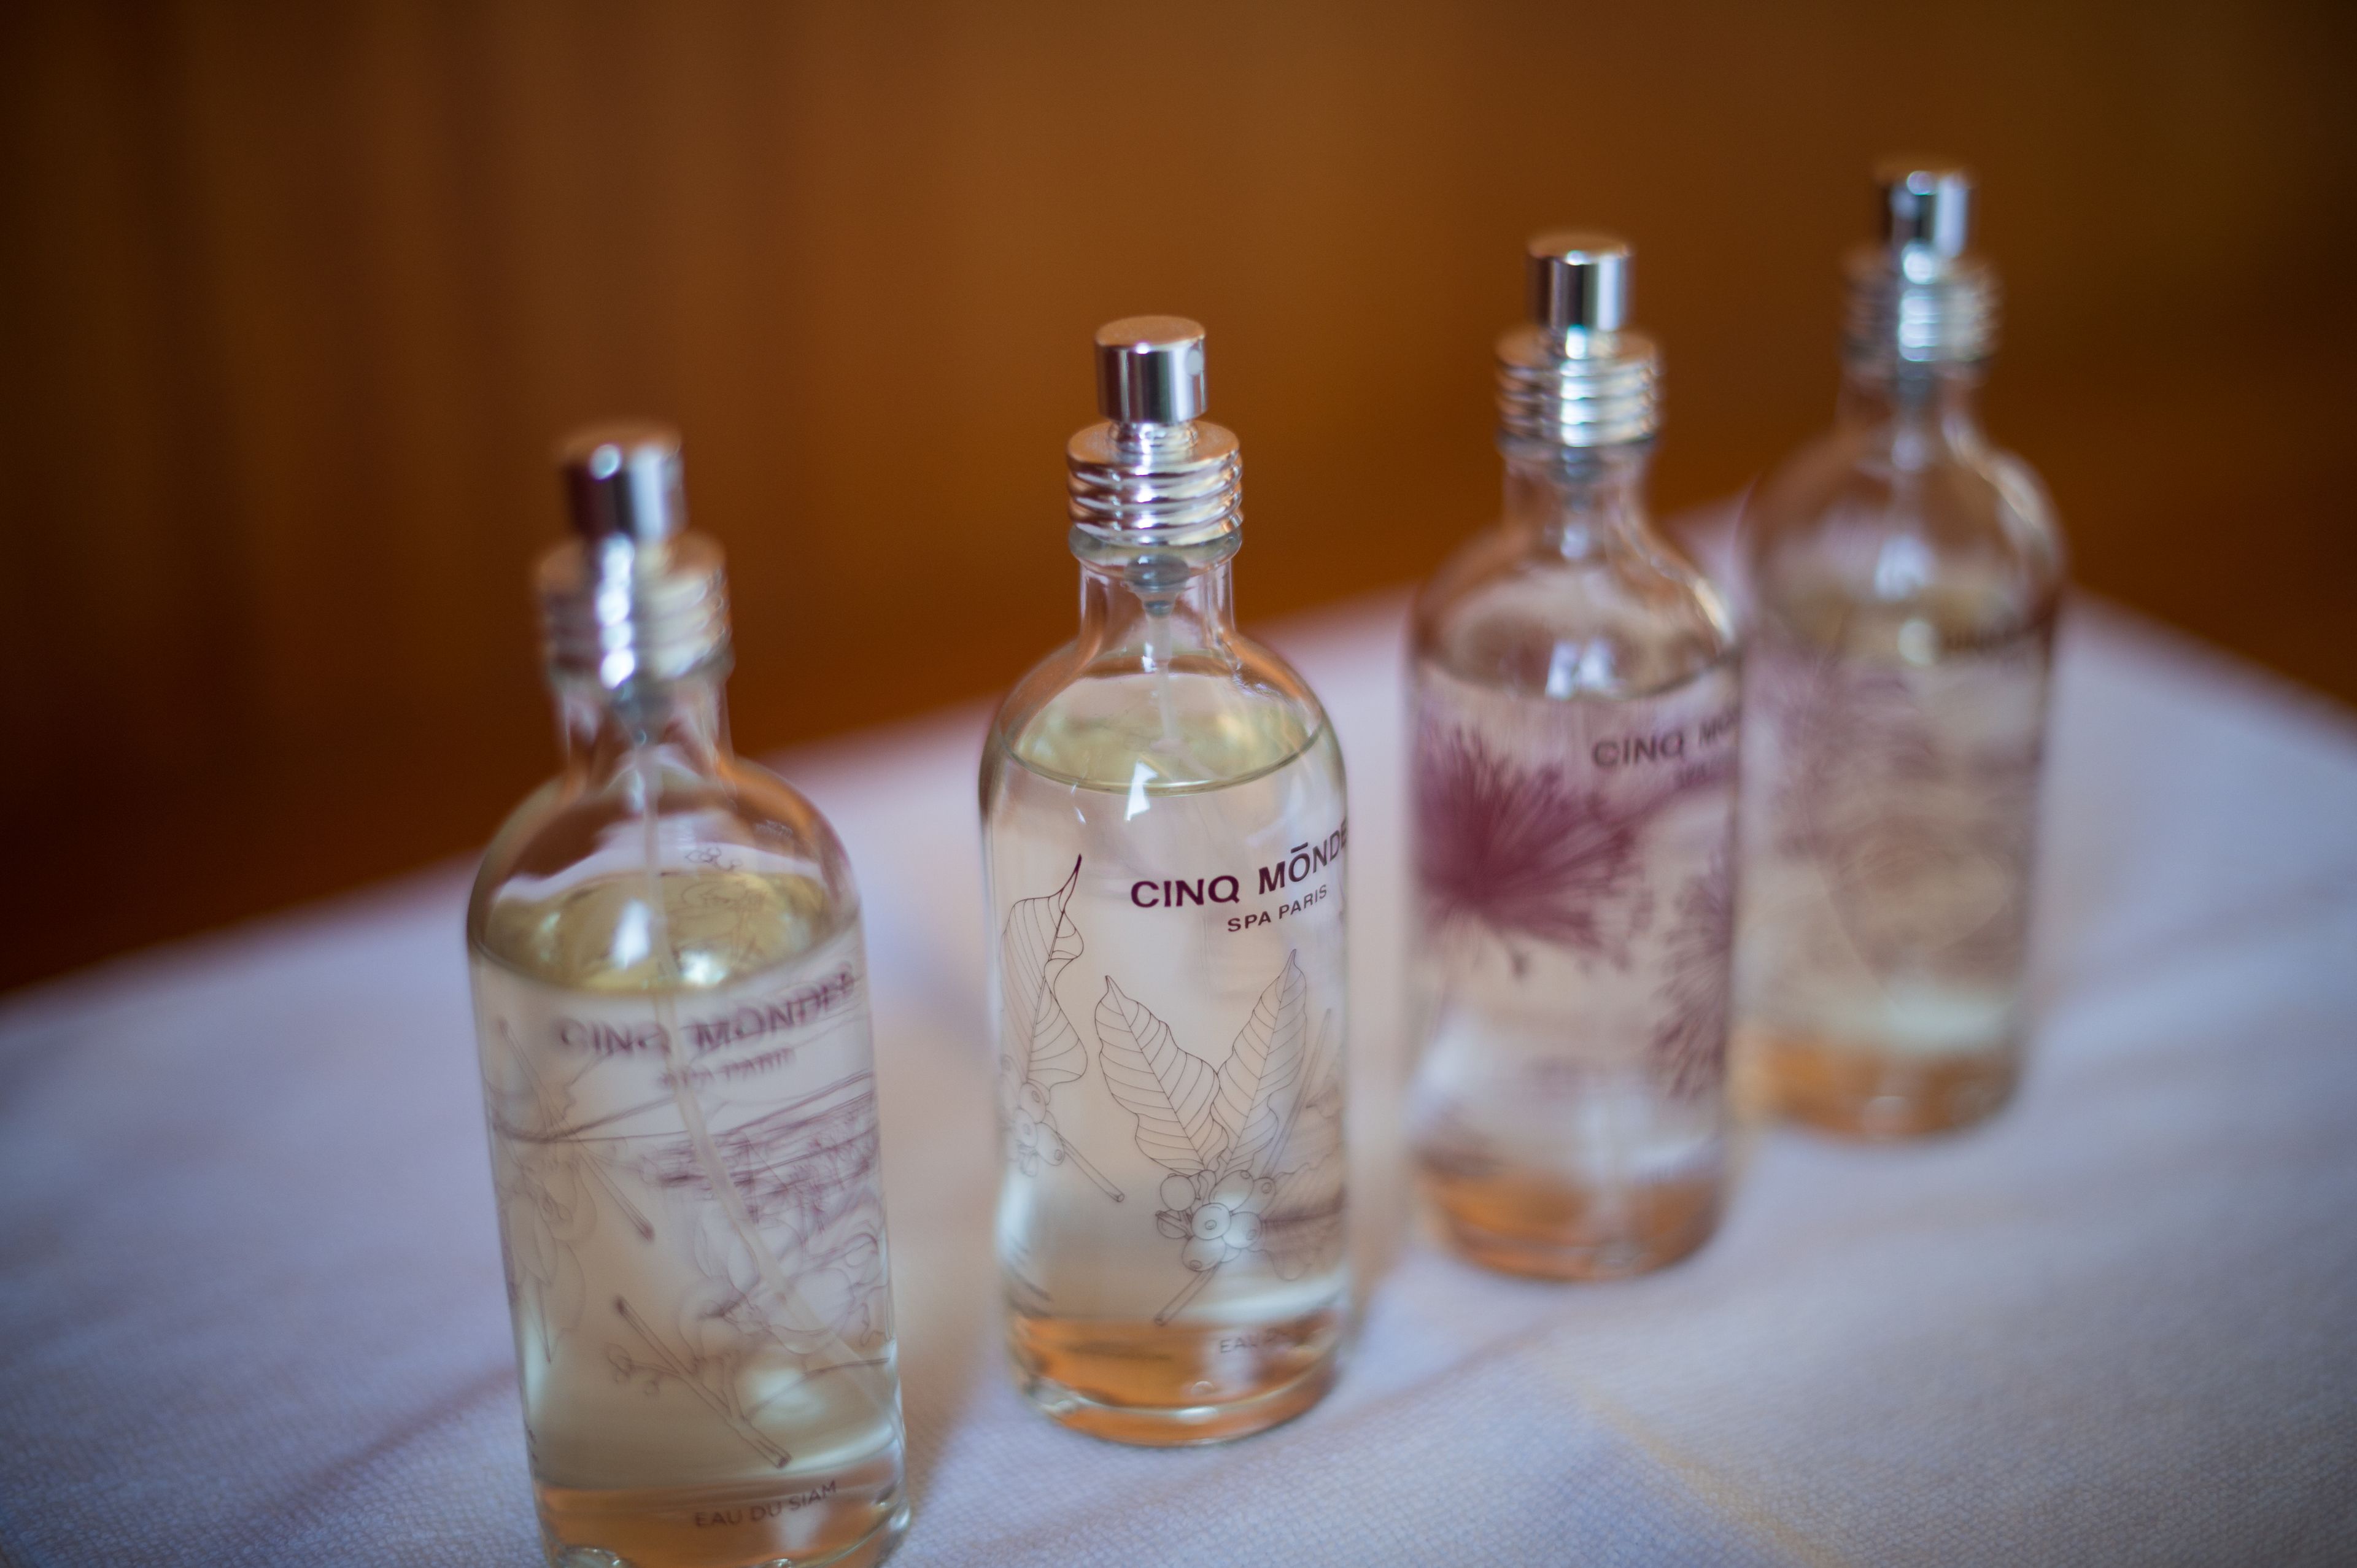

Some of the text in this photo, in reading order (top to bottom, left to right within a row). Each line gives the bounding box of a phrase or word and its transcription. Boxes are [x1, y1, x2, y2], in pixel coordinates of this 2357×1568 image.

[1131, 875, 1239, 908] CINQ
[1228, 884, 1327, 932] SPA PARIS
[694, 1479, 837, 1527] EAU DU SIAM
